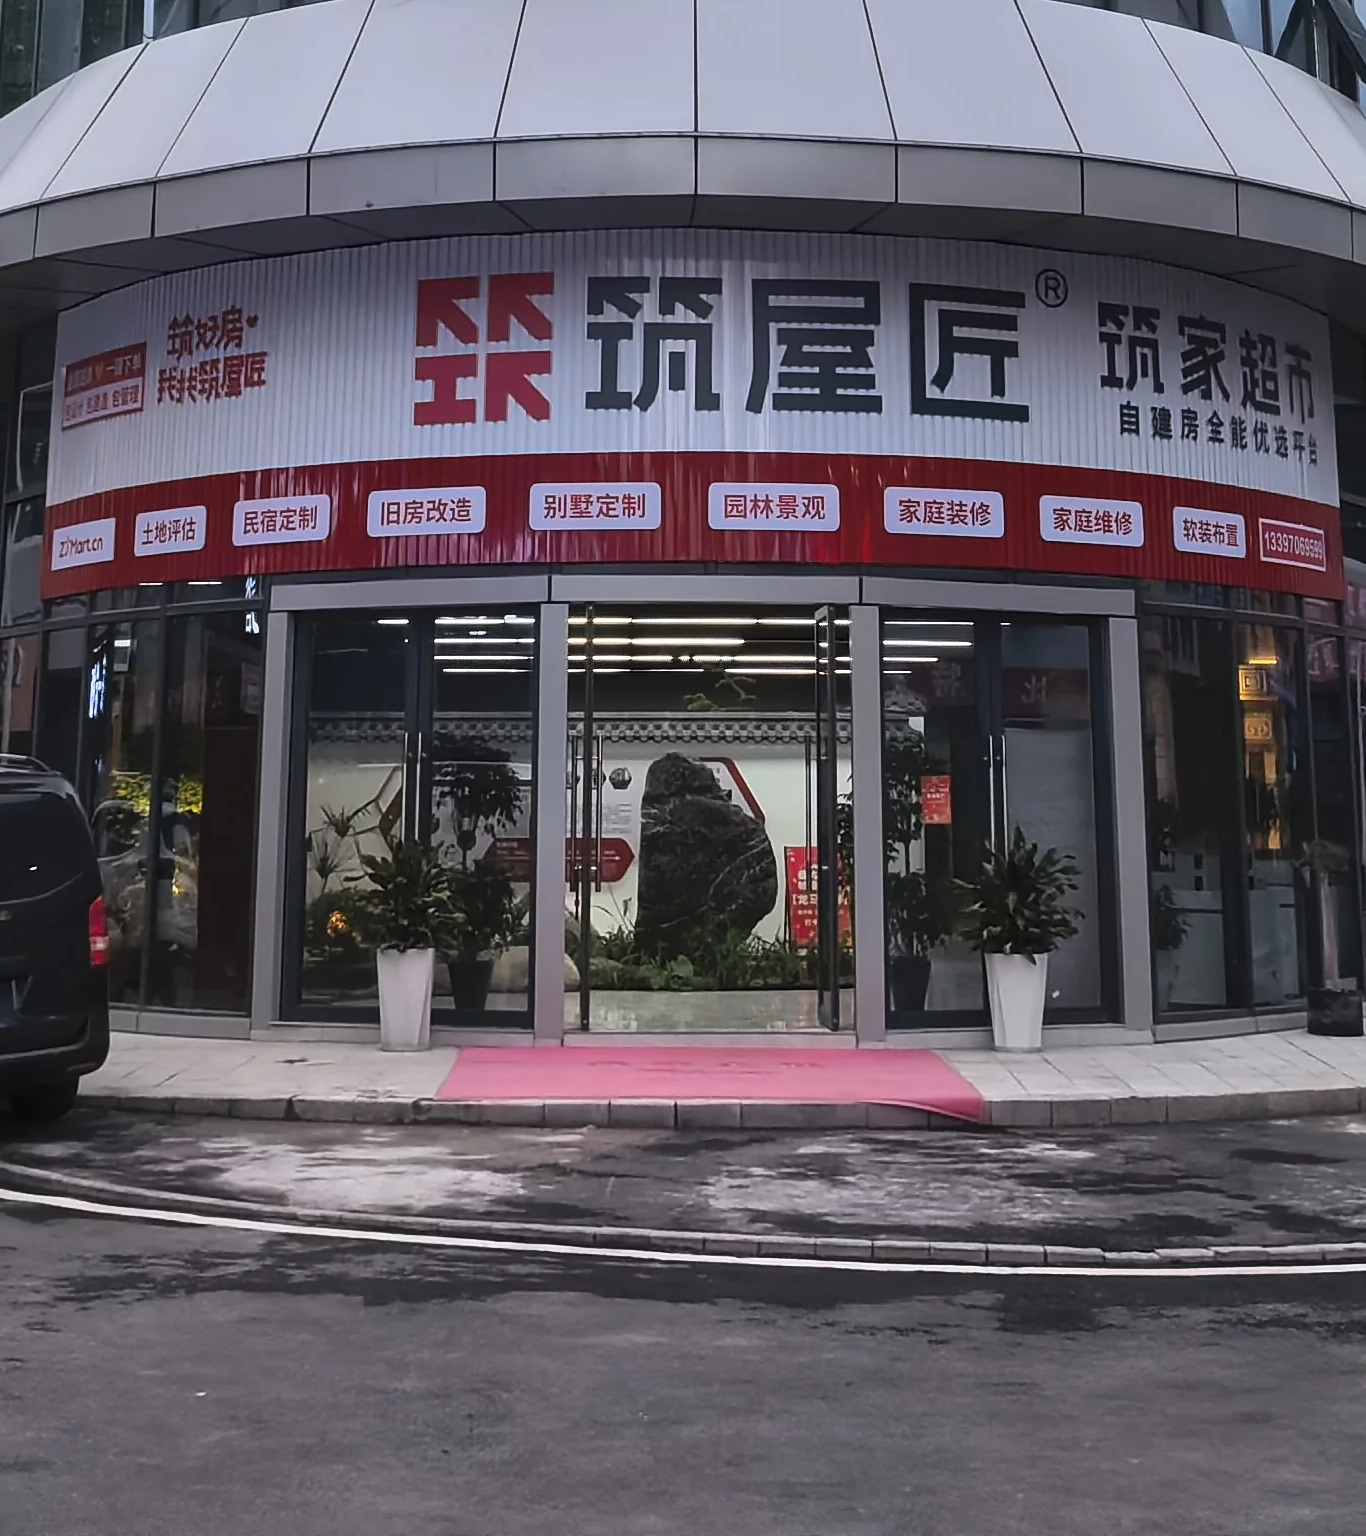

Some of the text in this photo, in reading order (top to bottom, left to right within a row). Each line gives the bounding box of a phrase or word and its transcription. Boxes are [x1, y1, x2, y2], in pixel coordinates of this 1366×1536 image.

[166, 305, 244, 362] 筑好房
[1097, 301, 1316, 425] 筑家超市
[1118, 401, 1320, 467] 自建房全能优选平台
[242, 505, 318, 535] 民宿定制
[380, 498, 472, 526] 旧房改造
[542, 491, 647, 521] 别墅定制
[723, 493, 826, 521] 园林景观
[897, 499, 992, 528] 家庭装修
[141, 517, 197, 546] 土地评估
[1051, 507, 1133, 536] 家庭维修
[1182, 517, 1239, 547] 软装布置
[1264, 530, 1323, 560] 13397069599
